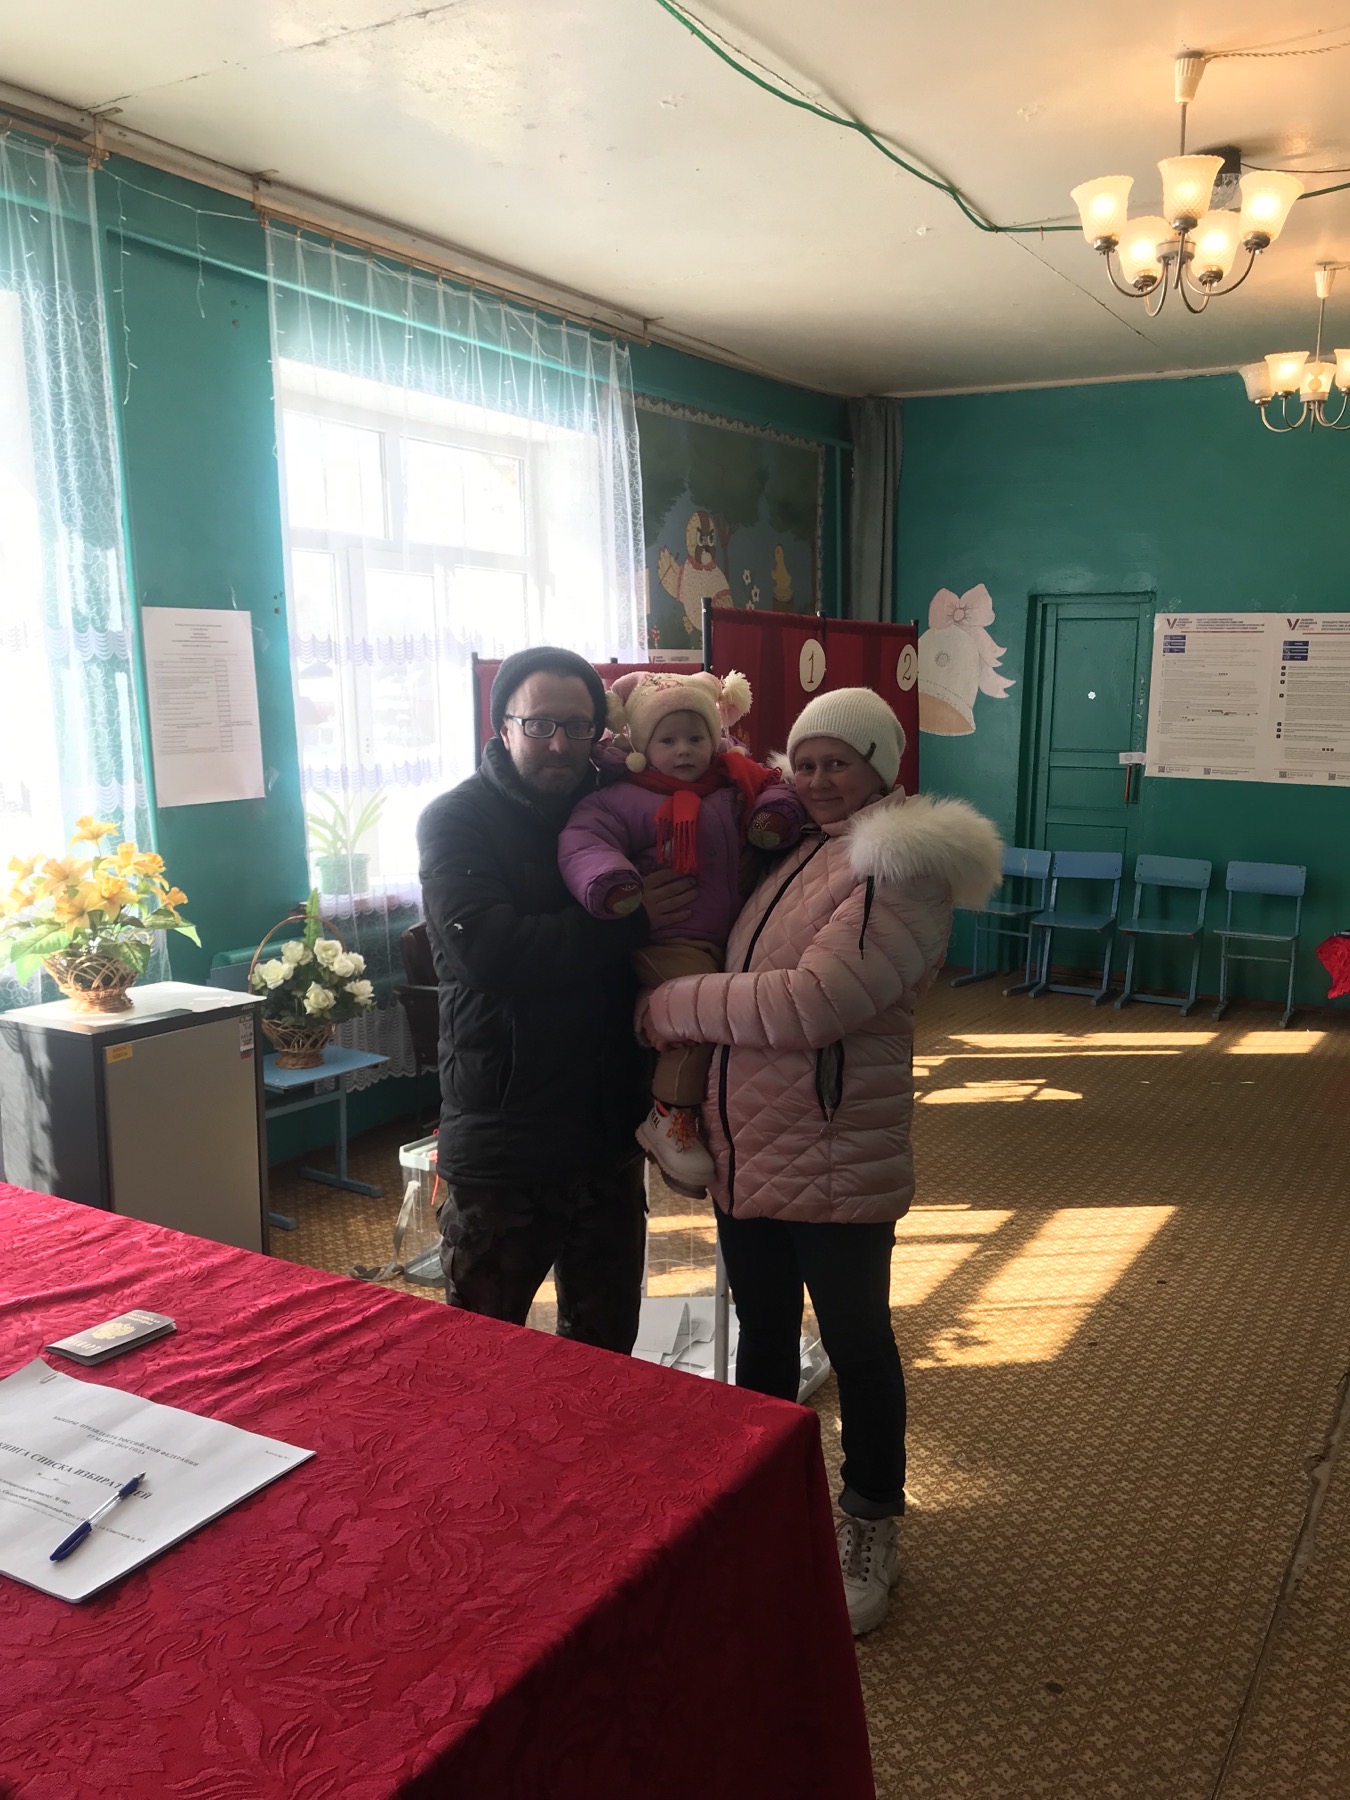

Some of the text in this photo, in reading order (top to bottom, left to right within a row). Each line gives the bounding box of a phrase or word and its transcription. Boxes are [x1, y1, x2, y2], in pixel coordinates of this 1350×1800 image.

[807, 650, 815, 684] 1
[902, 653, 912, 681] 2
[30, 1453, 74, 1473] СПИСКА
[73, 1468, 153, 1500] ИЗБИРАТЕЙ
